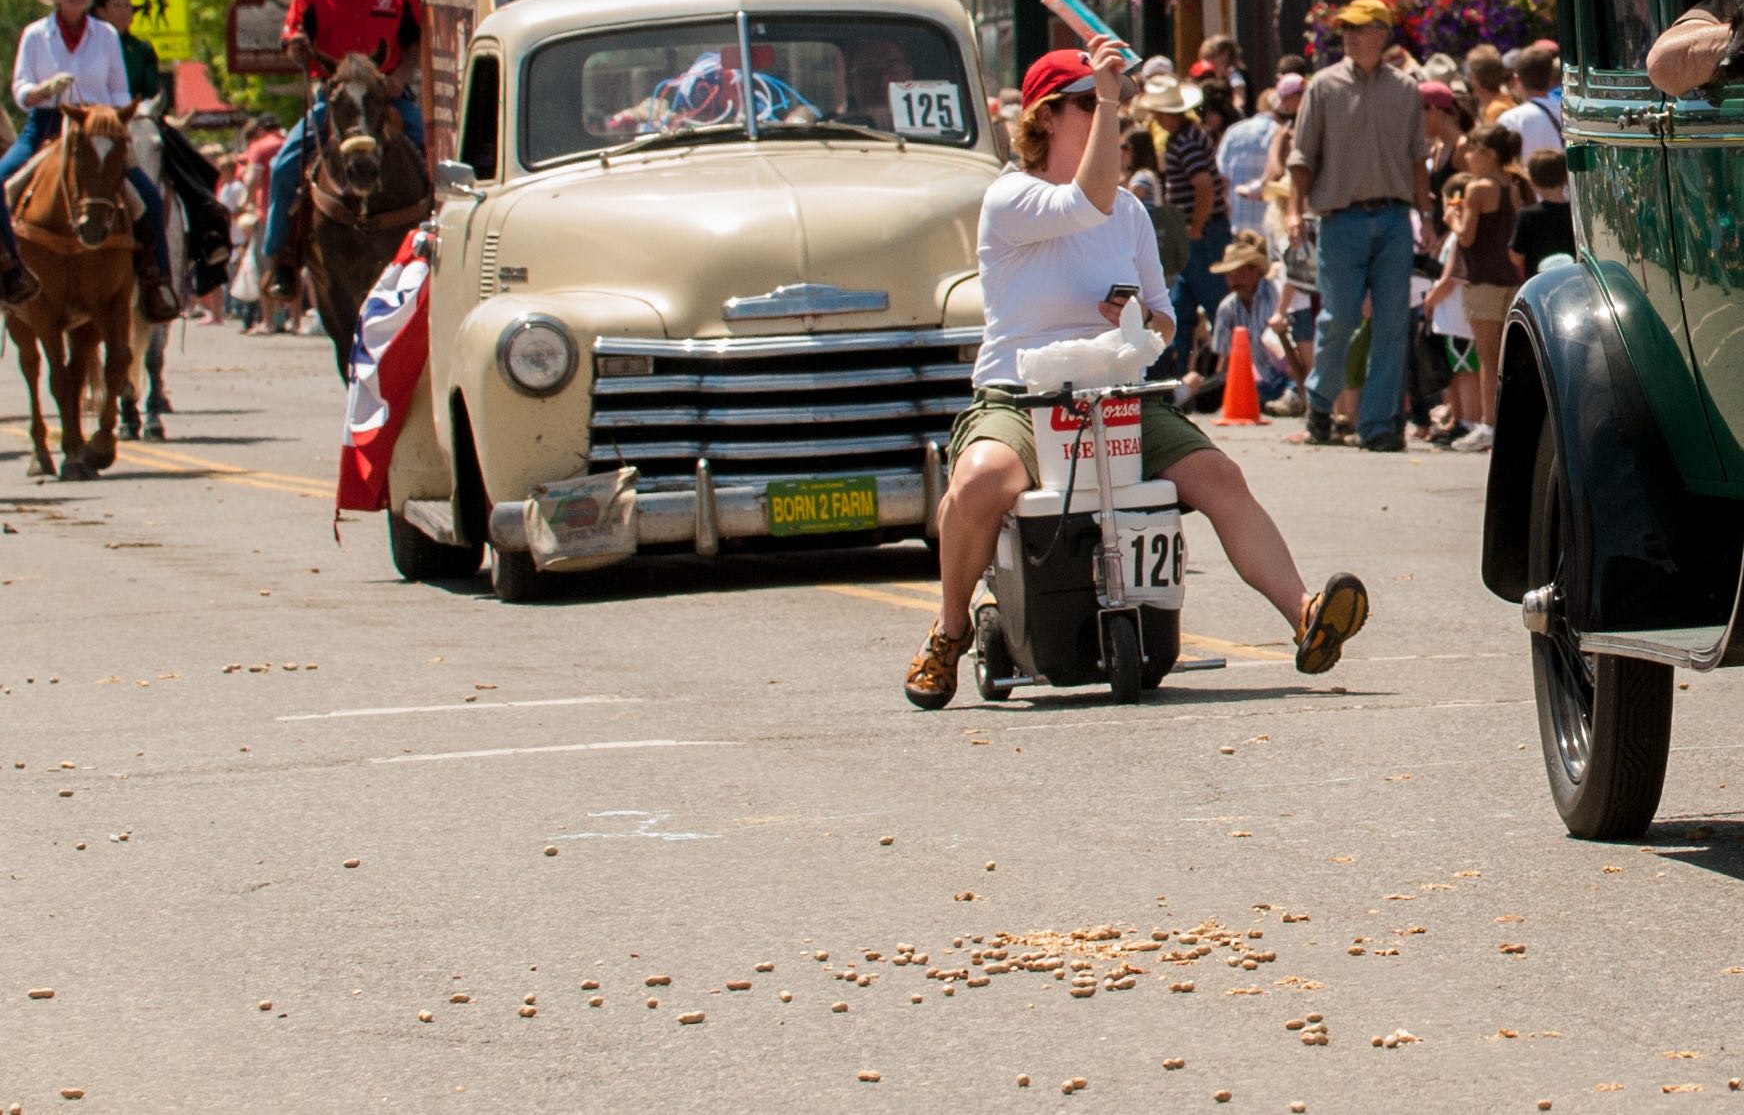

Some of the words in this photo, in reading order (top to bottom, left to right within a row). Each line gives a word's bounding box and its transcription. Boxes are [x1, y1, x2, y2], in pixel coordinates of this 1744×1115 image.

[902, 92, 954, 129] 125
[772, 493, 817, 524] BORN
[818, 493, 830, 521] 2
[831, 489, 875, 518] FARM
[1131, 531, 1184, 587] 126
